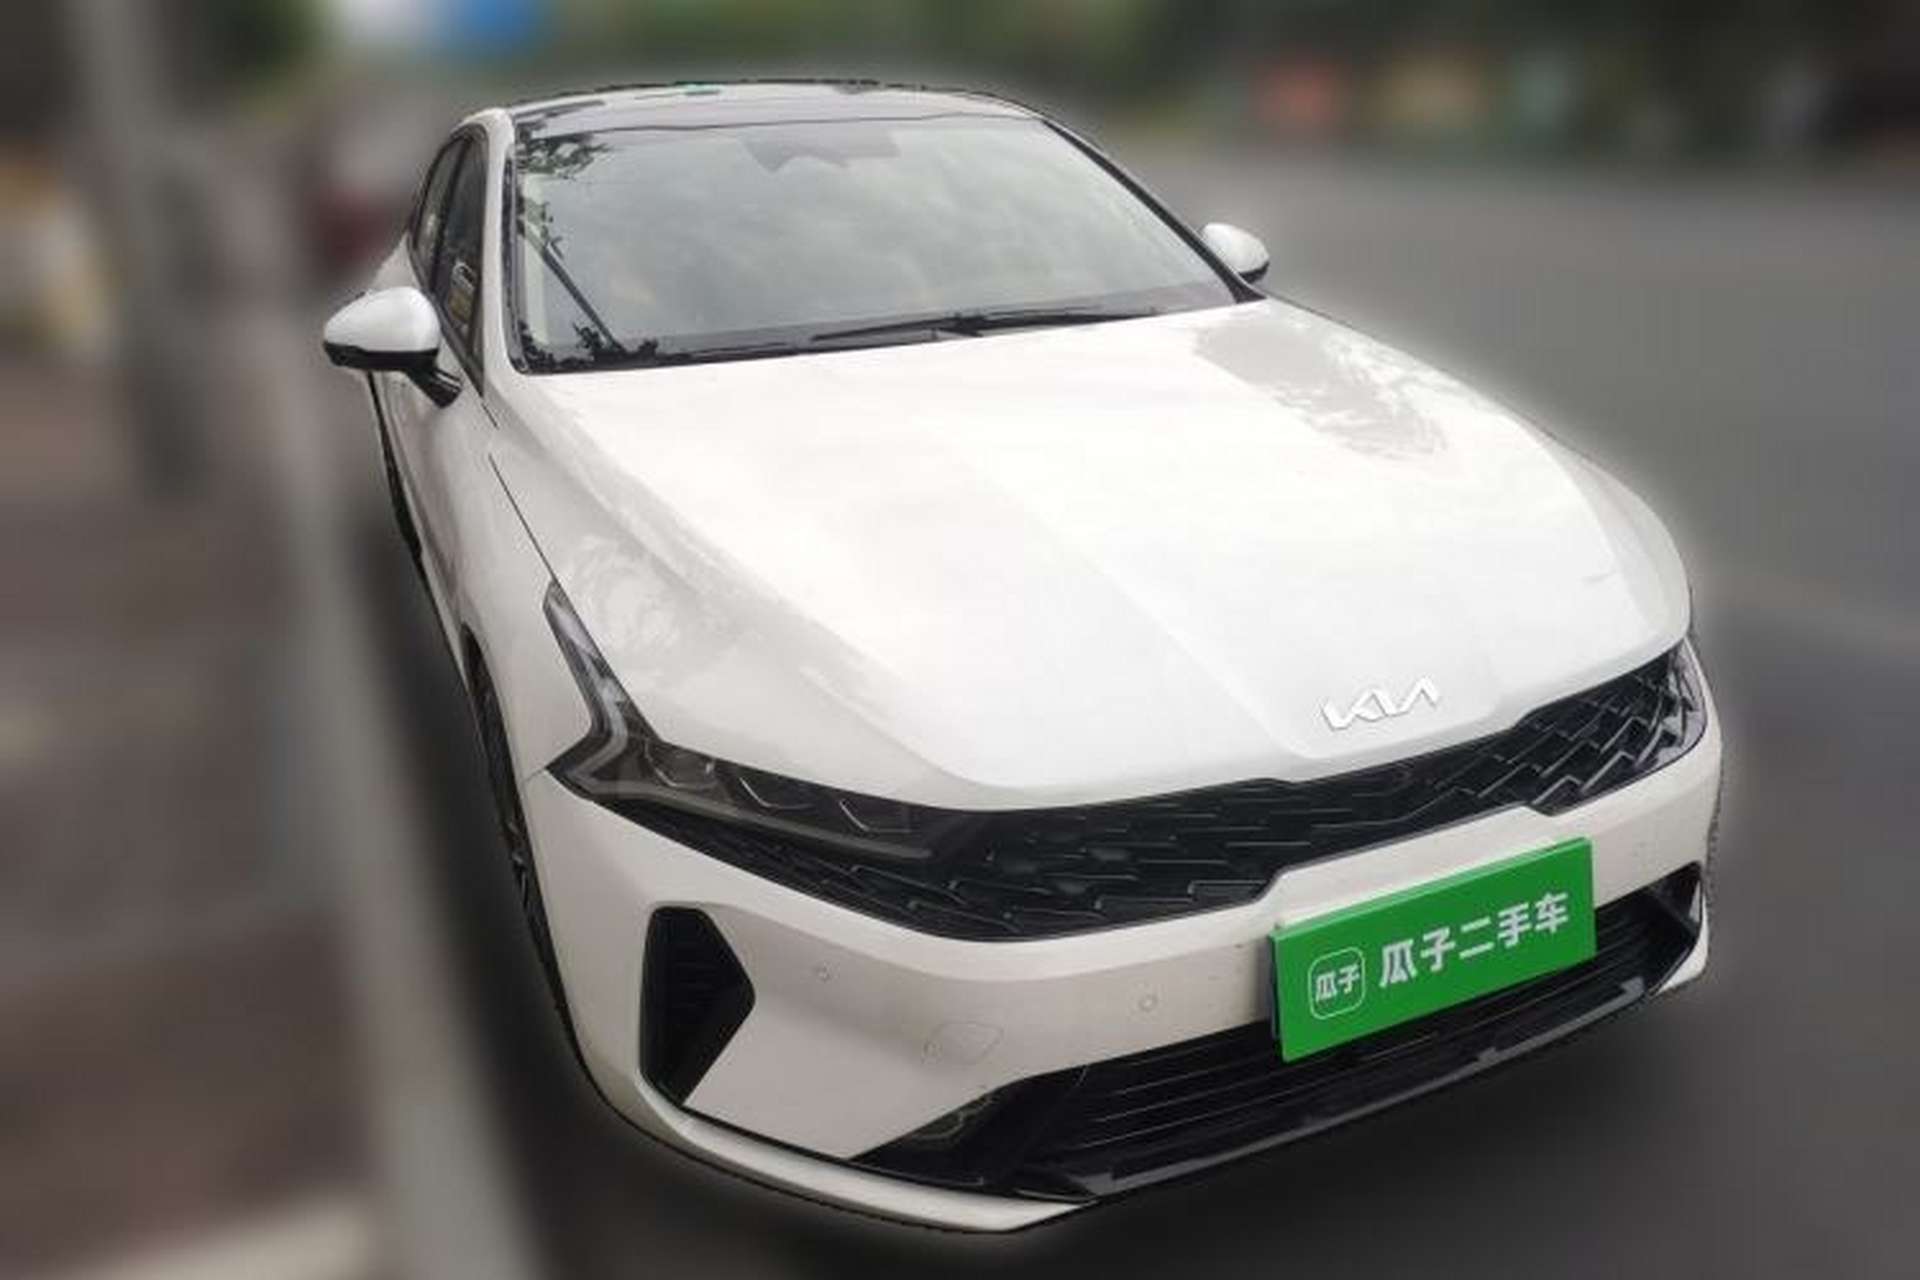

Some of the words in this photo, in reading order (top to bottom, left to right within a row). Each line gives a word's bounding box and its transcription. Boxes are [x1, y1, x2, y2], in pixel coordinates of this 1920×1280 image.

[1379, 892, 1569, 988] 瓜子二手车
[1315, 964, 1361, 1001] 瓜子
